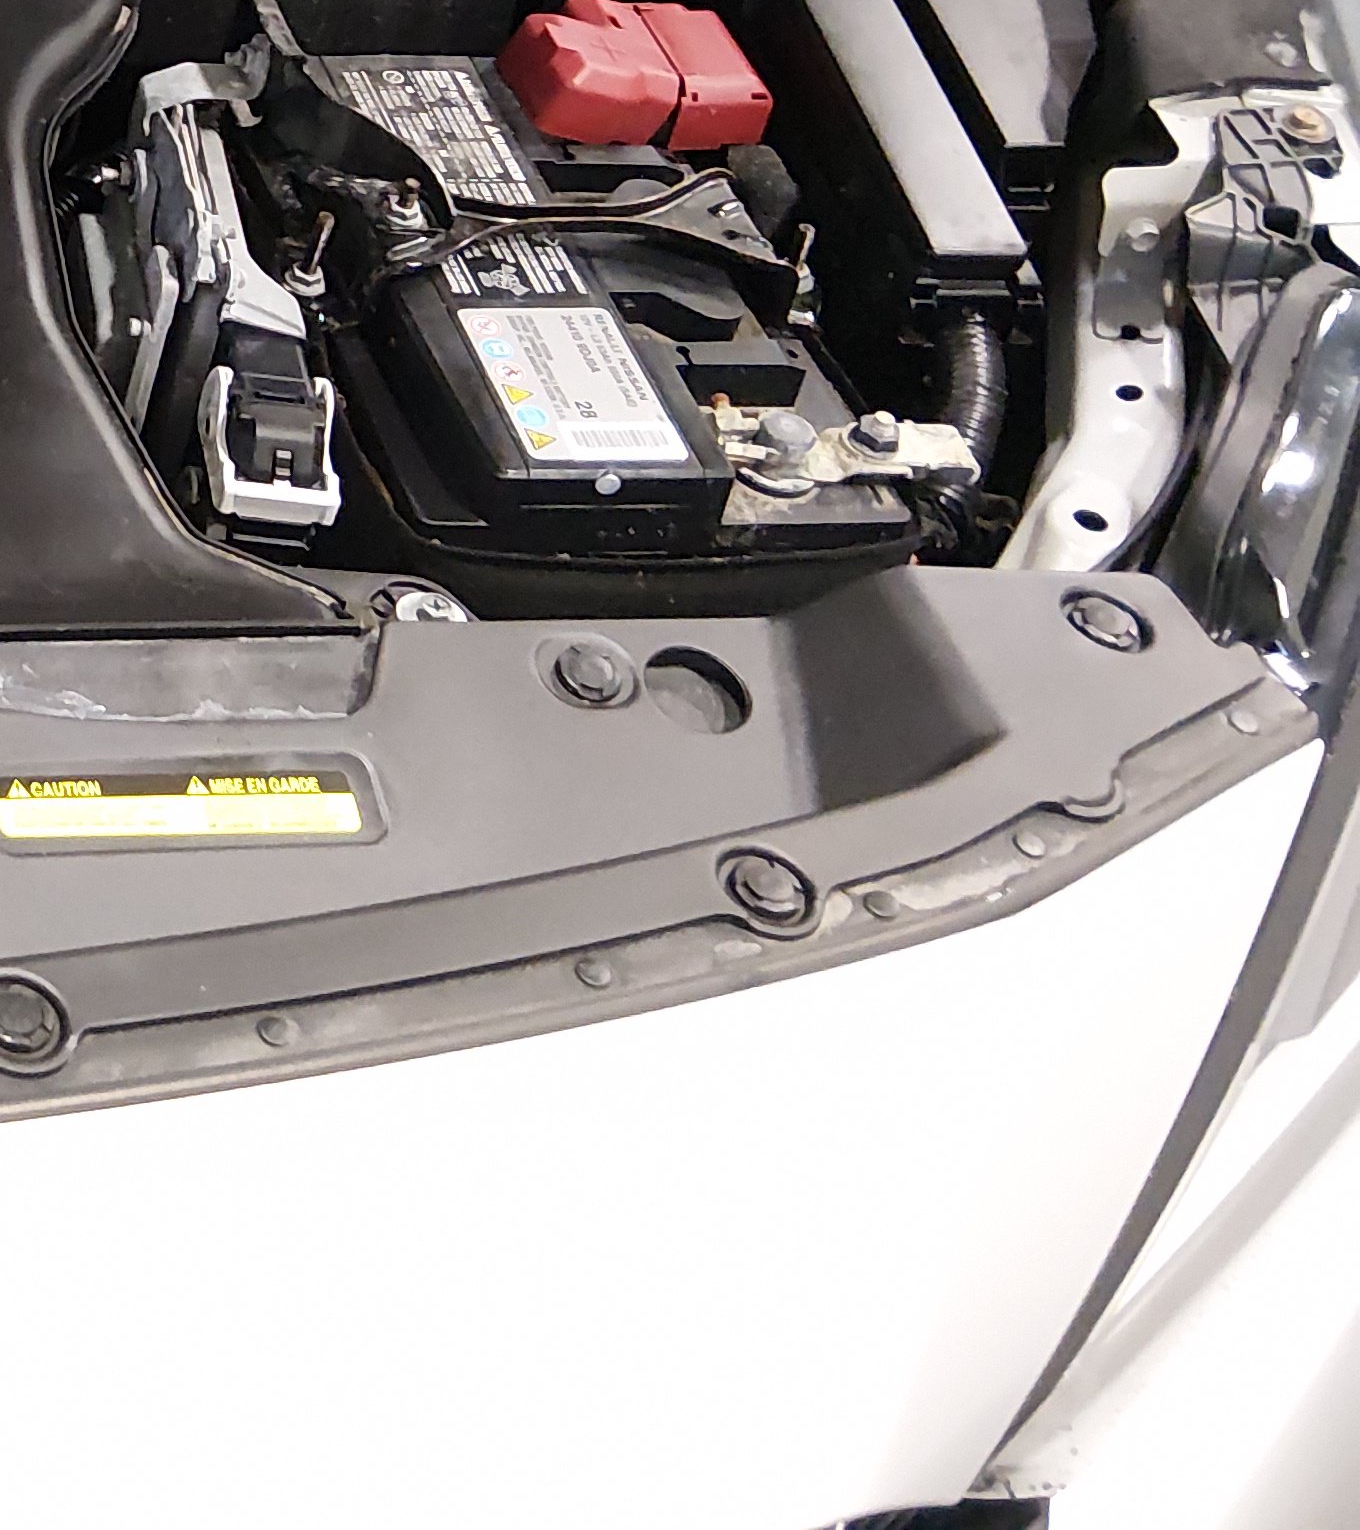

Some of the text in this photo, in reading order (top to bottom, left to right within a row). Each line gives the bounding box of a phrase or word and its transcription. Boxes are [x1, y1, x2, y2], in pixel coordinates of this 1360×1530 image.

[618, 357, 649, 401] NISSAN
[30, 780, 101, 798] CAUTION
[209, 776, 320, 795] MISE EN GARDE
